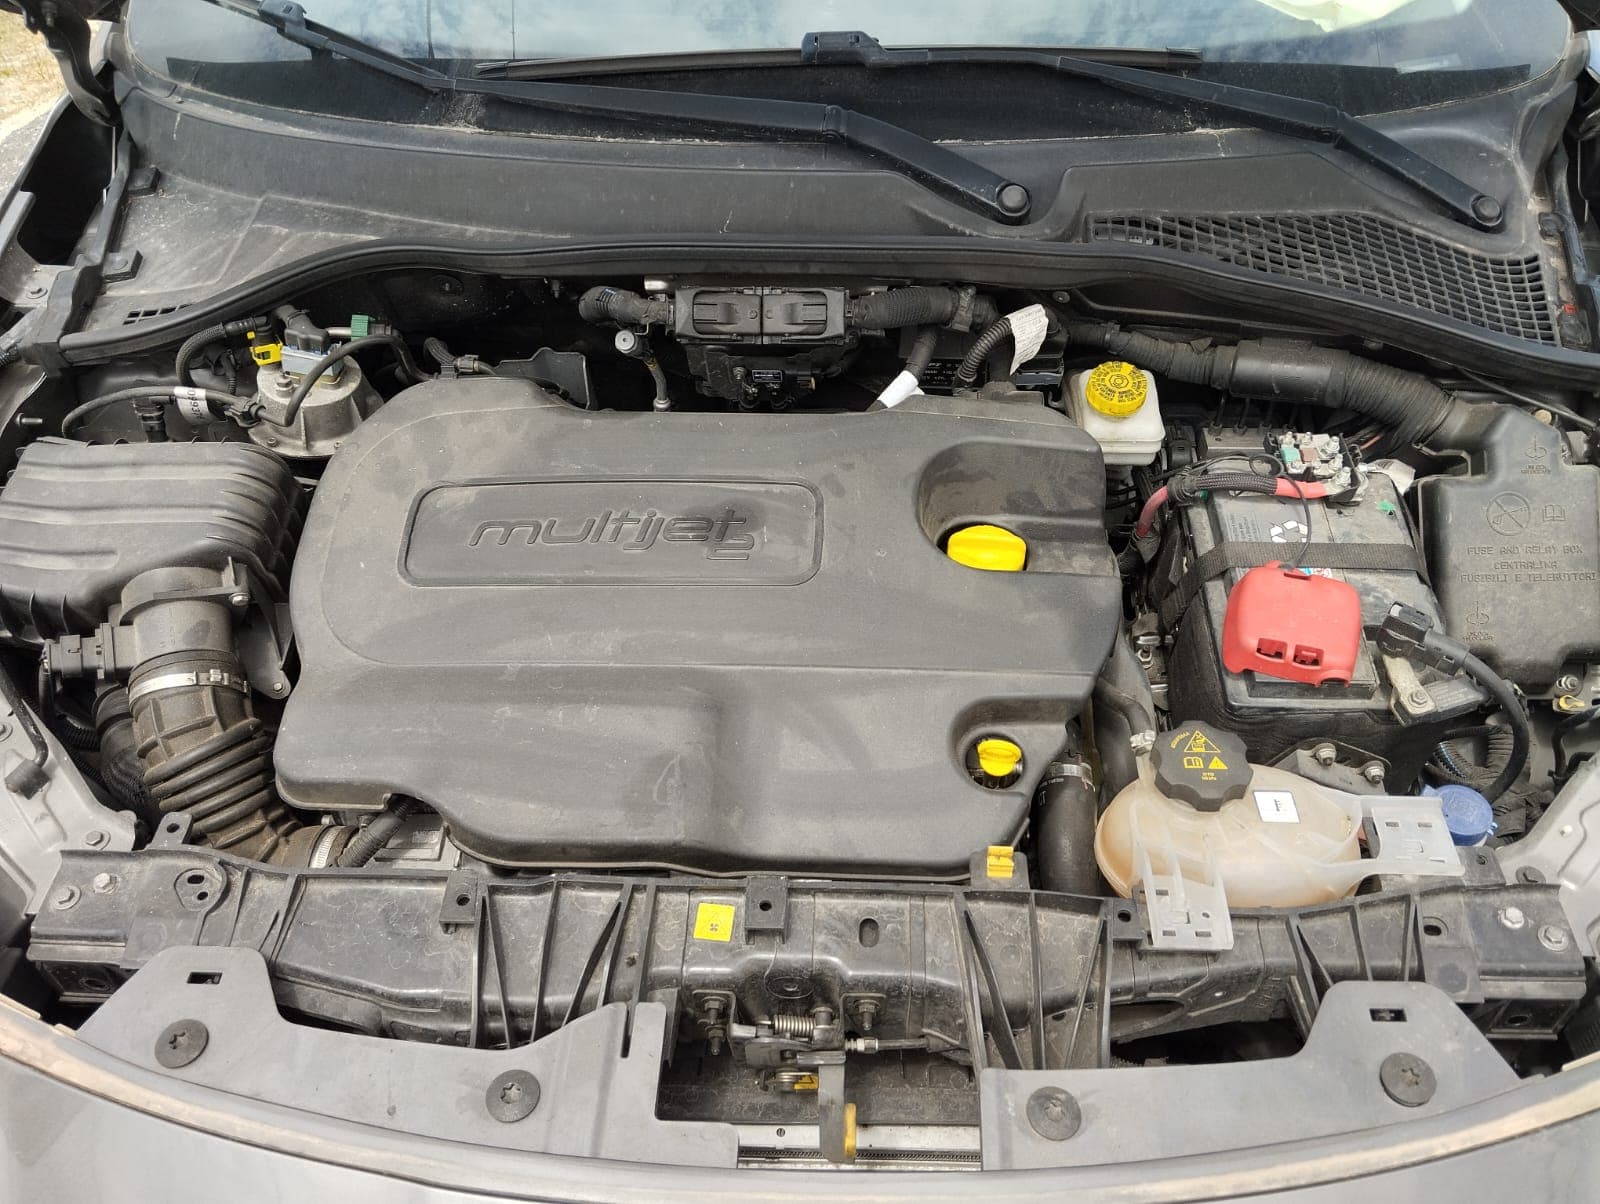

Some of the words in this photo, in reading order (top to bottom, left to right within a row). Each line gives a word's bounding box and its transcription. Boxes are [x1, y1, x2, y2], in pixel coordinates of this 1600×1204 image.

[469, 508, 747, 551] multijet
[1467, 546, 1494, 555] FUSE
[1500, 545, 1520, 555] AND
[1525, 545, 1557, 554] RELAY
[1563, 544, 1584, 554] BOX
[1494, 560, 1558, 570] CENTRALINA
[1460, 573, 1508, 583] FUSIBILI
[1514, 573, 1522, 583] E
